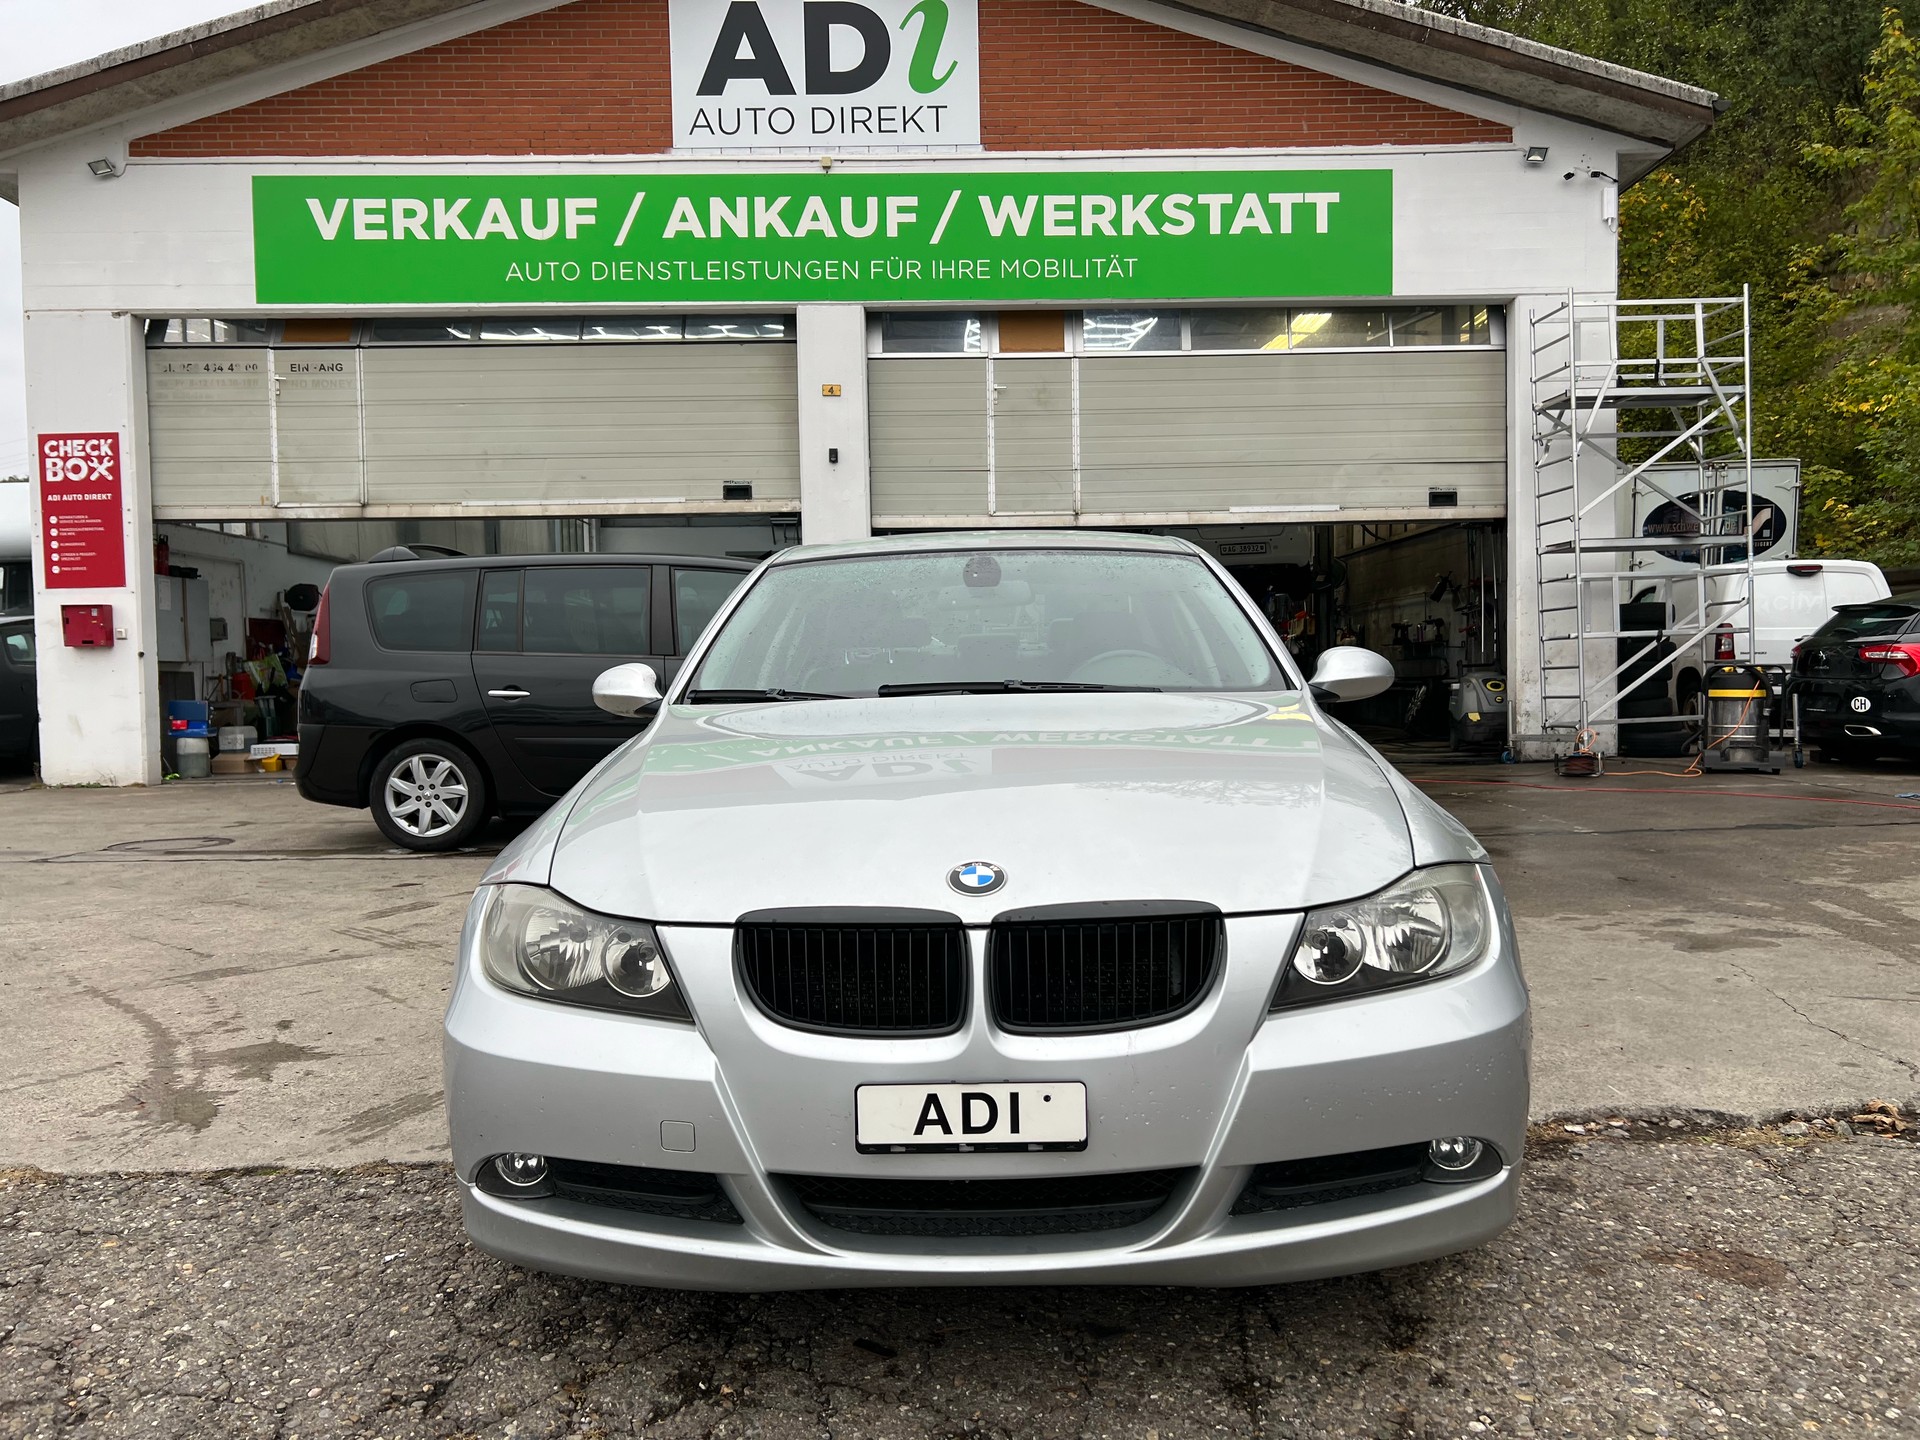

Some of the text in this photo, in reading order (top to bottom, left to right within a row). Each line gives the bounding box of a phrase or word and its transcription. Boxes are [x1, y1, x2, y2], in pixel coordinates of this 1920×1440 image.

[689, 105, 948, 136] AUTO DIREKT
[305, 189, 1340, 246] VERKAUF / ANKAUF / WERKSTATT
[506, 254, 1139, 282] AUTO DIENSTLEISTUNGEN FÜR IHRE MOBILITÄT
[290, 362, 344, 373] EINANG
[827, 386, 835, 395] 4
[44, 439, 113, 457] CHECK
[47, 494, 61, 502] ADI
[84, 493, 112, 501] DIREKT
[1853, 698, 1867, 711] CH
[912, 1091, 1021, 1136] ADI
